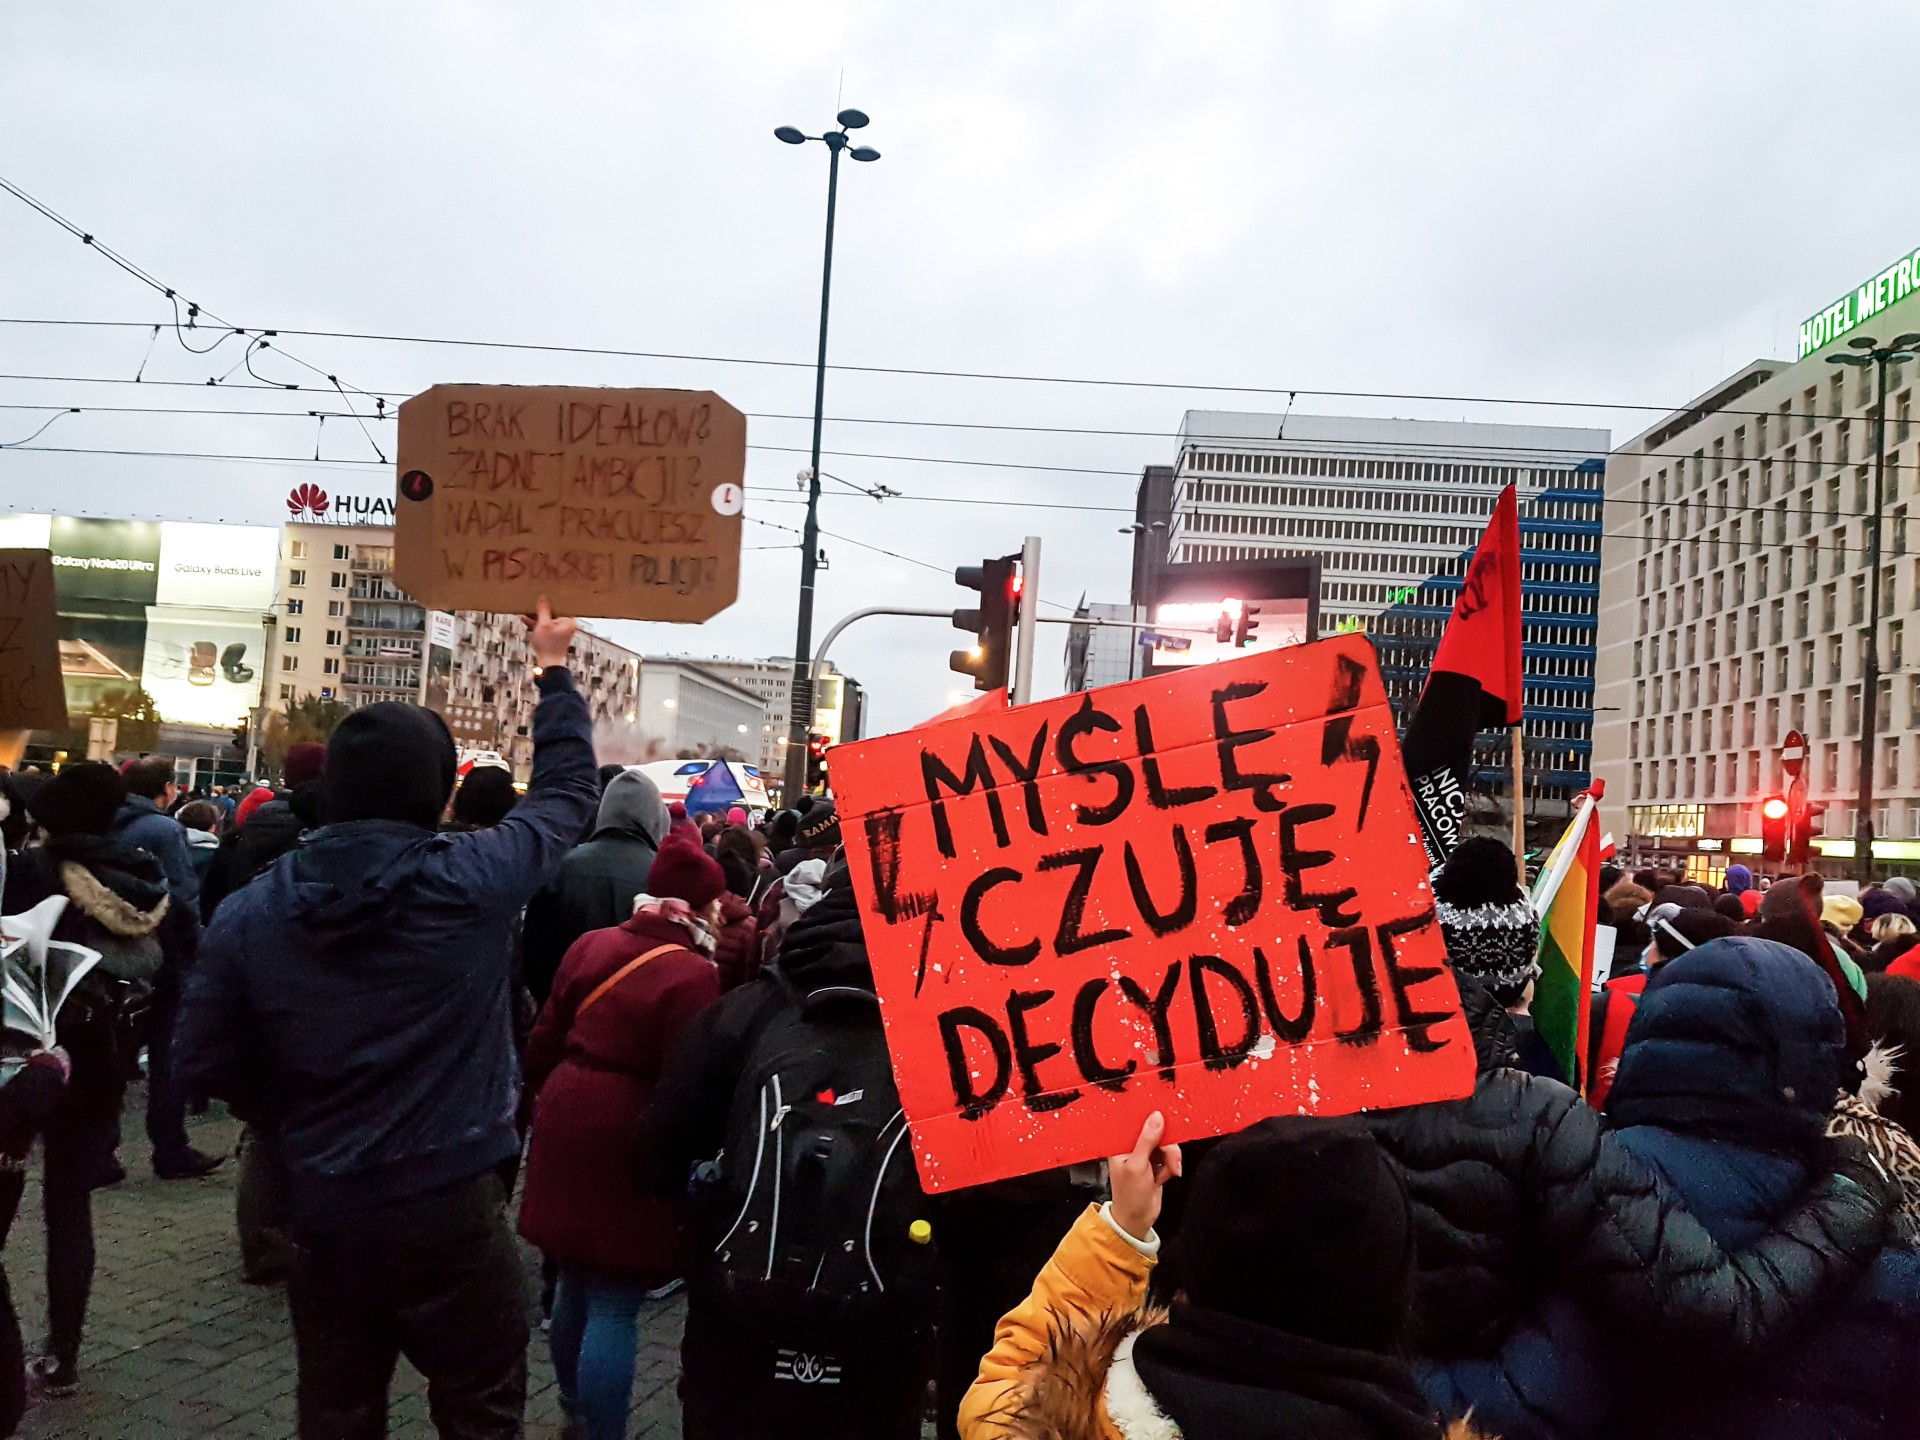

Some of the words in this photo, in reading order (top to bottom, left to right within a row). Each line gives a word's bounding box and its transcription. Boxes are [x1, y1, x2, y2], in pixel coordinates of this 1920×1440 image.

[1799, 296, 1855, 358] HOTEL
[447, 401, 526, 440] BRAK
[446, 501, 532, 538] NADAL
[52, 555, 90, 569] Galaxy
[174, 563, 211, 576] Galaxy
[214, 565, 239, 576] Buds
[241, 567, 262, 577] Live
[443, 549, 468, 580] W
[920, 682, 1292, 859] MYŚLĘ
[960, 803, 1362, 966] CZUJĘ
[937, 907, 1457, 1122] DECYDUJĘ
